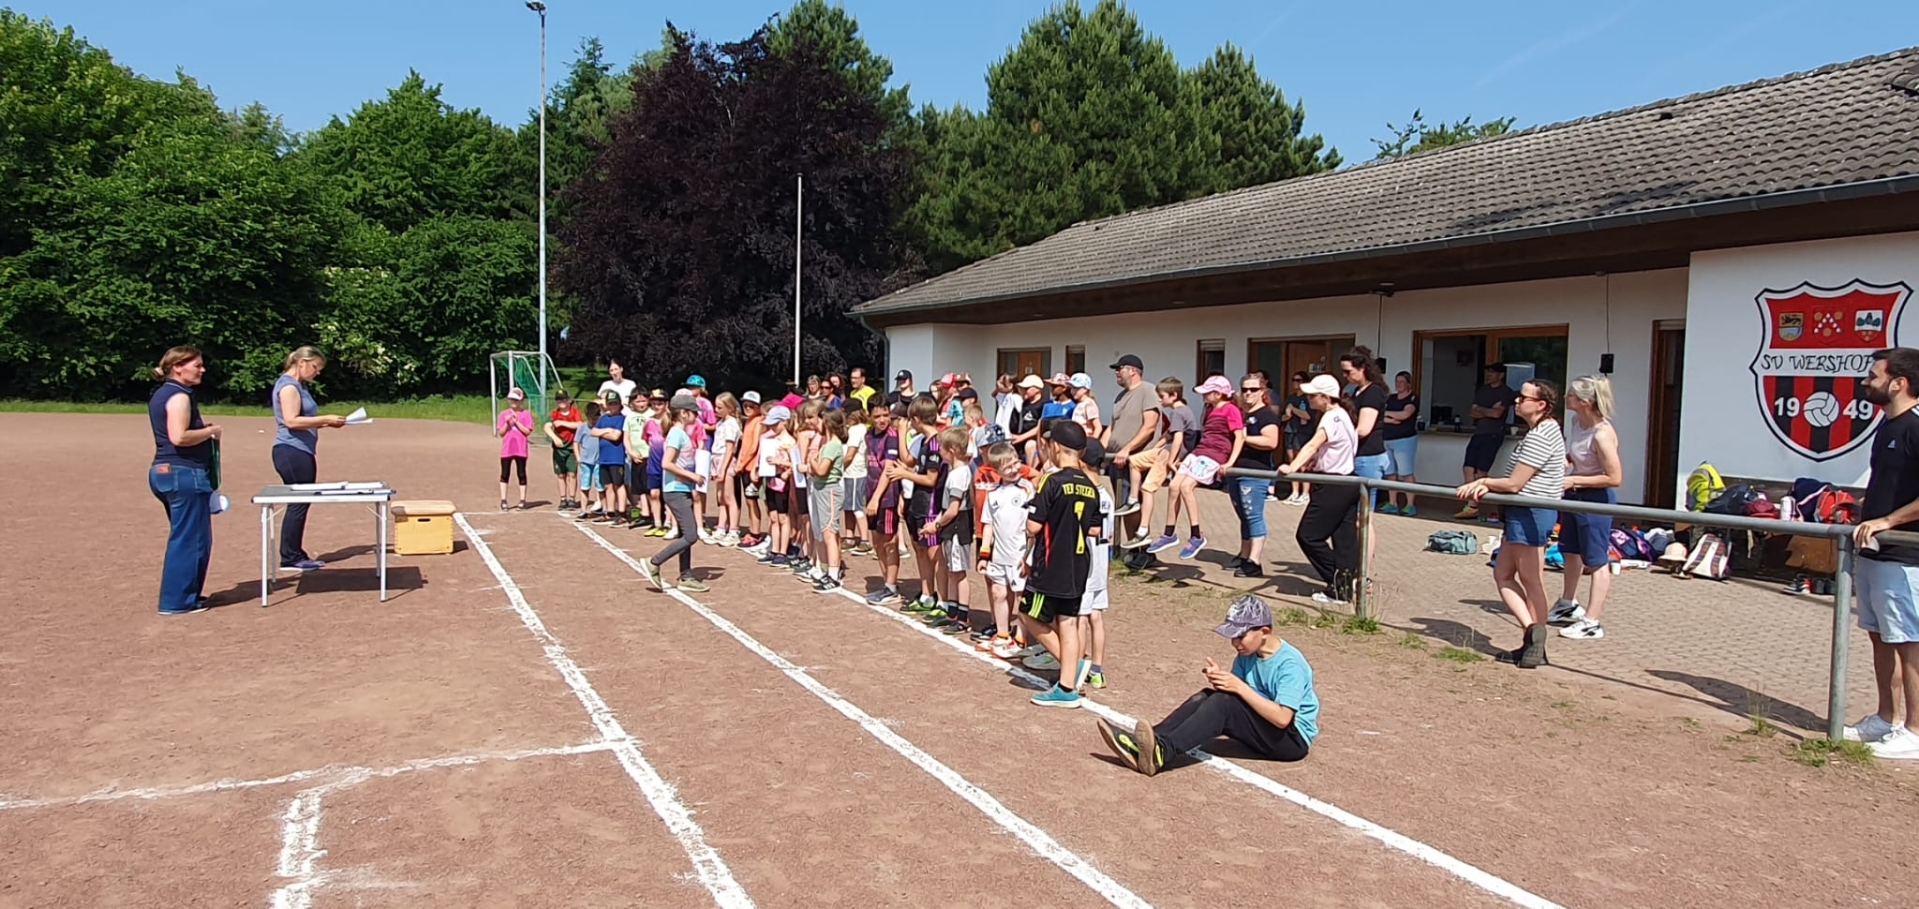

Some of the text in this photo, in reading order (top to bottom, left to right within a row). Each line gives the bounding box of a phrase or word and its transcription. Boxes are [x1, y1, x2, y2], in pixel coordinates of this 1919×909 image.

[1761, 353, 1874, 374] SV WERSHOF
[1774, 397, 1874, 420] 19 49
